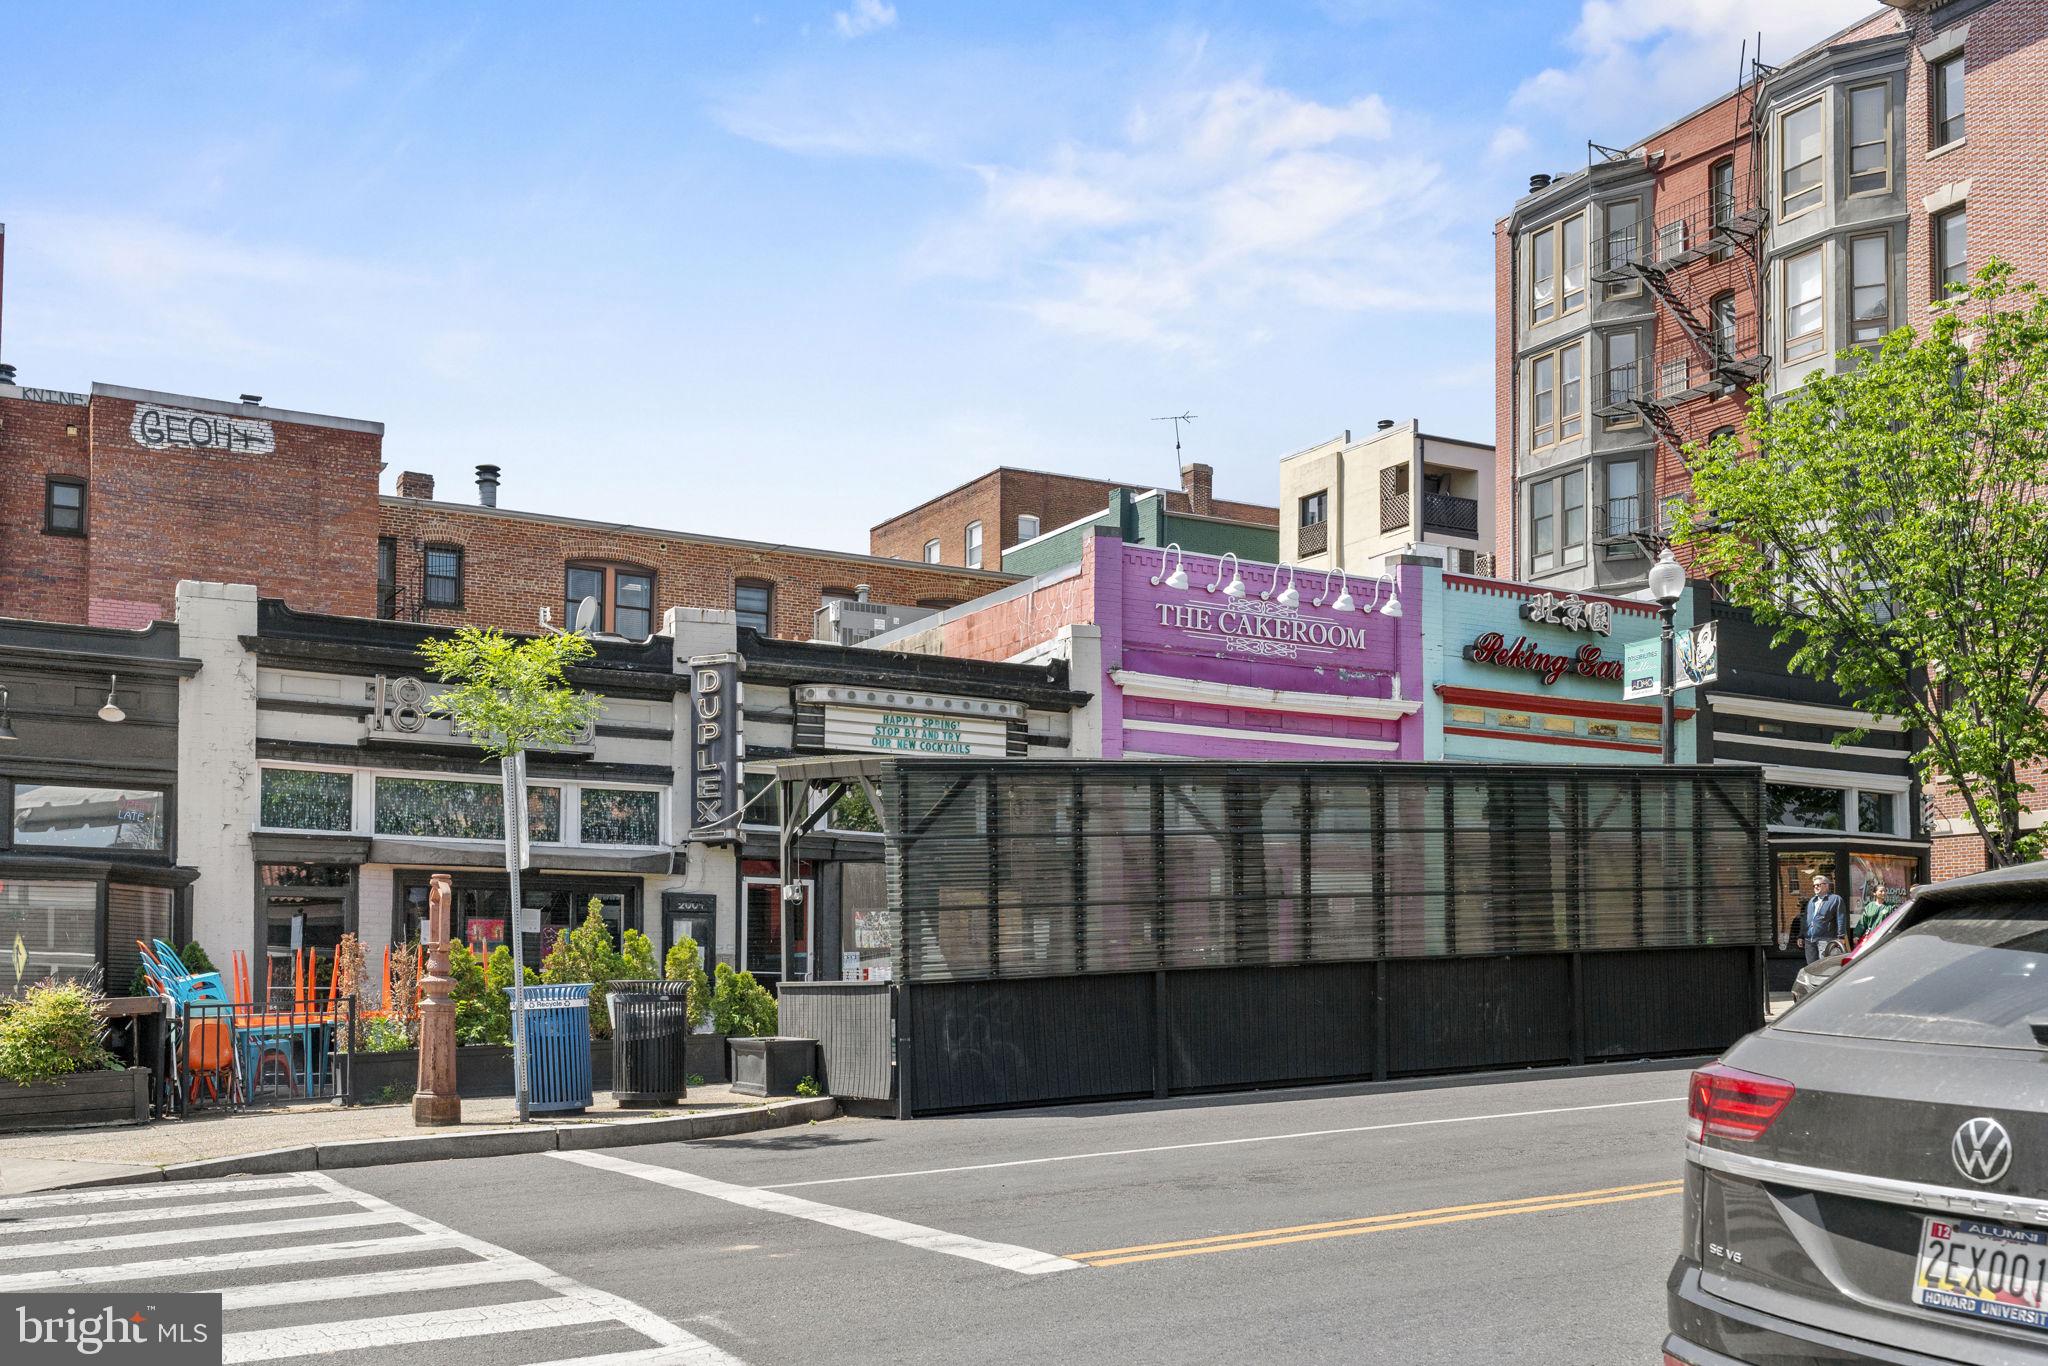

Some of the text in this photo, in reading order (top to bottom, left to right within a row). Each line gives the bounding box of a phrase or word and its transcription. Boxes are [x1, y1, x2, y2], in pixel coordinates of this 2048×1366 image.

[1156, 603, 1366, 650] THE CAKEROOM
[1473, 632, 1624, 685] Peking Gar
[883, 715, 916, 726] HAPPY
[875, 726, 961, 742] STOP BY AND TRY
[697, 669, 722, 823] DUPLEX
[871, 738, 971, 754] OUR NEW COCKTAILS
[118, 810, 145, 823] LATE
[536, 1000, 563, 1009] Recycle
[1912, 1189, 2048, 1221] ATLAS
[1937, 1225, 1951, 1239] 12
[1968, 1224, 2039, 1242] ALUMNI
[1709, 1243, 1742, 1263] SE V6
[1925, 1239, 2047, 1303] 2EX001
[1924, 1291, 2048, 1325] HOWARD UNIVERSIT
